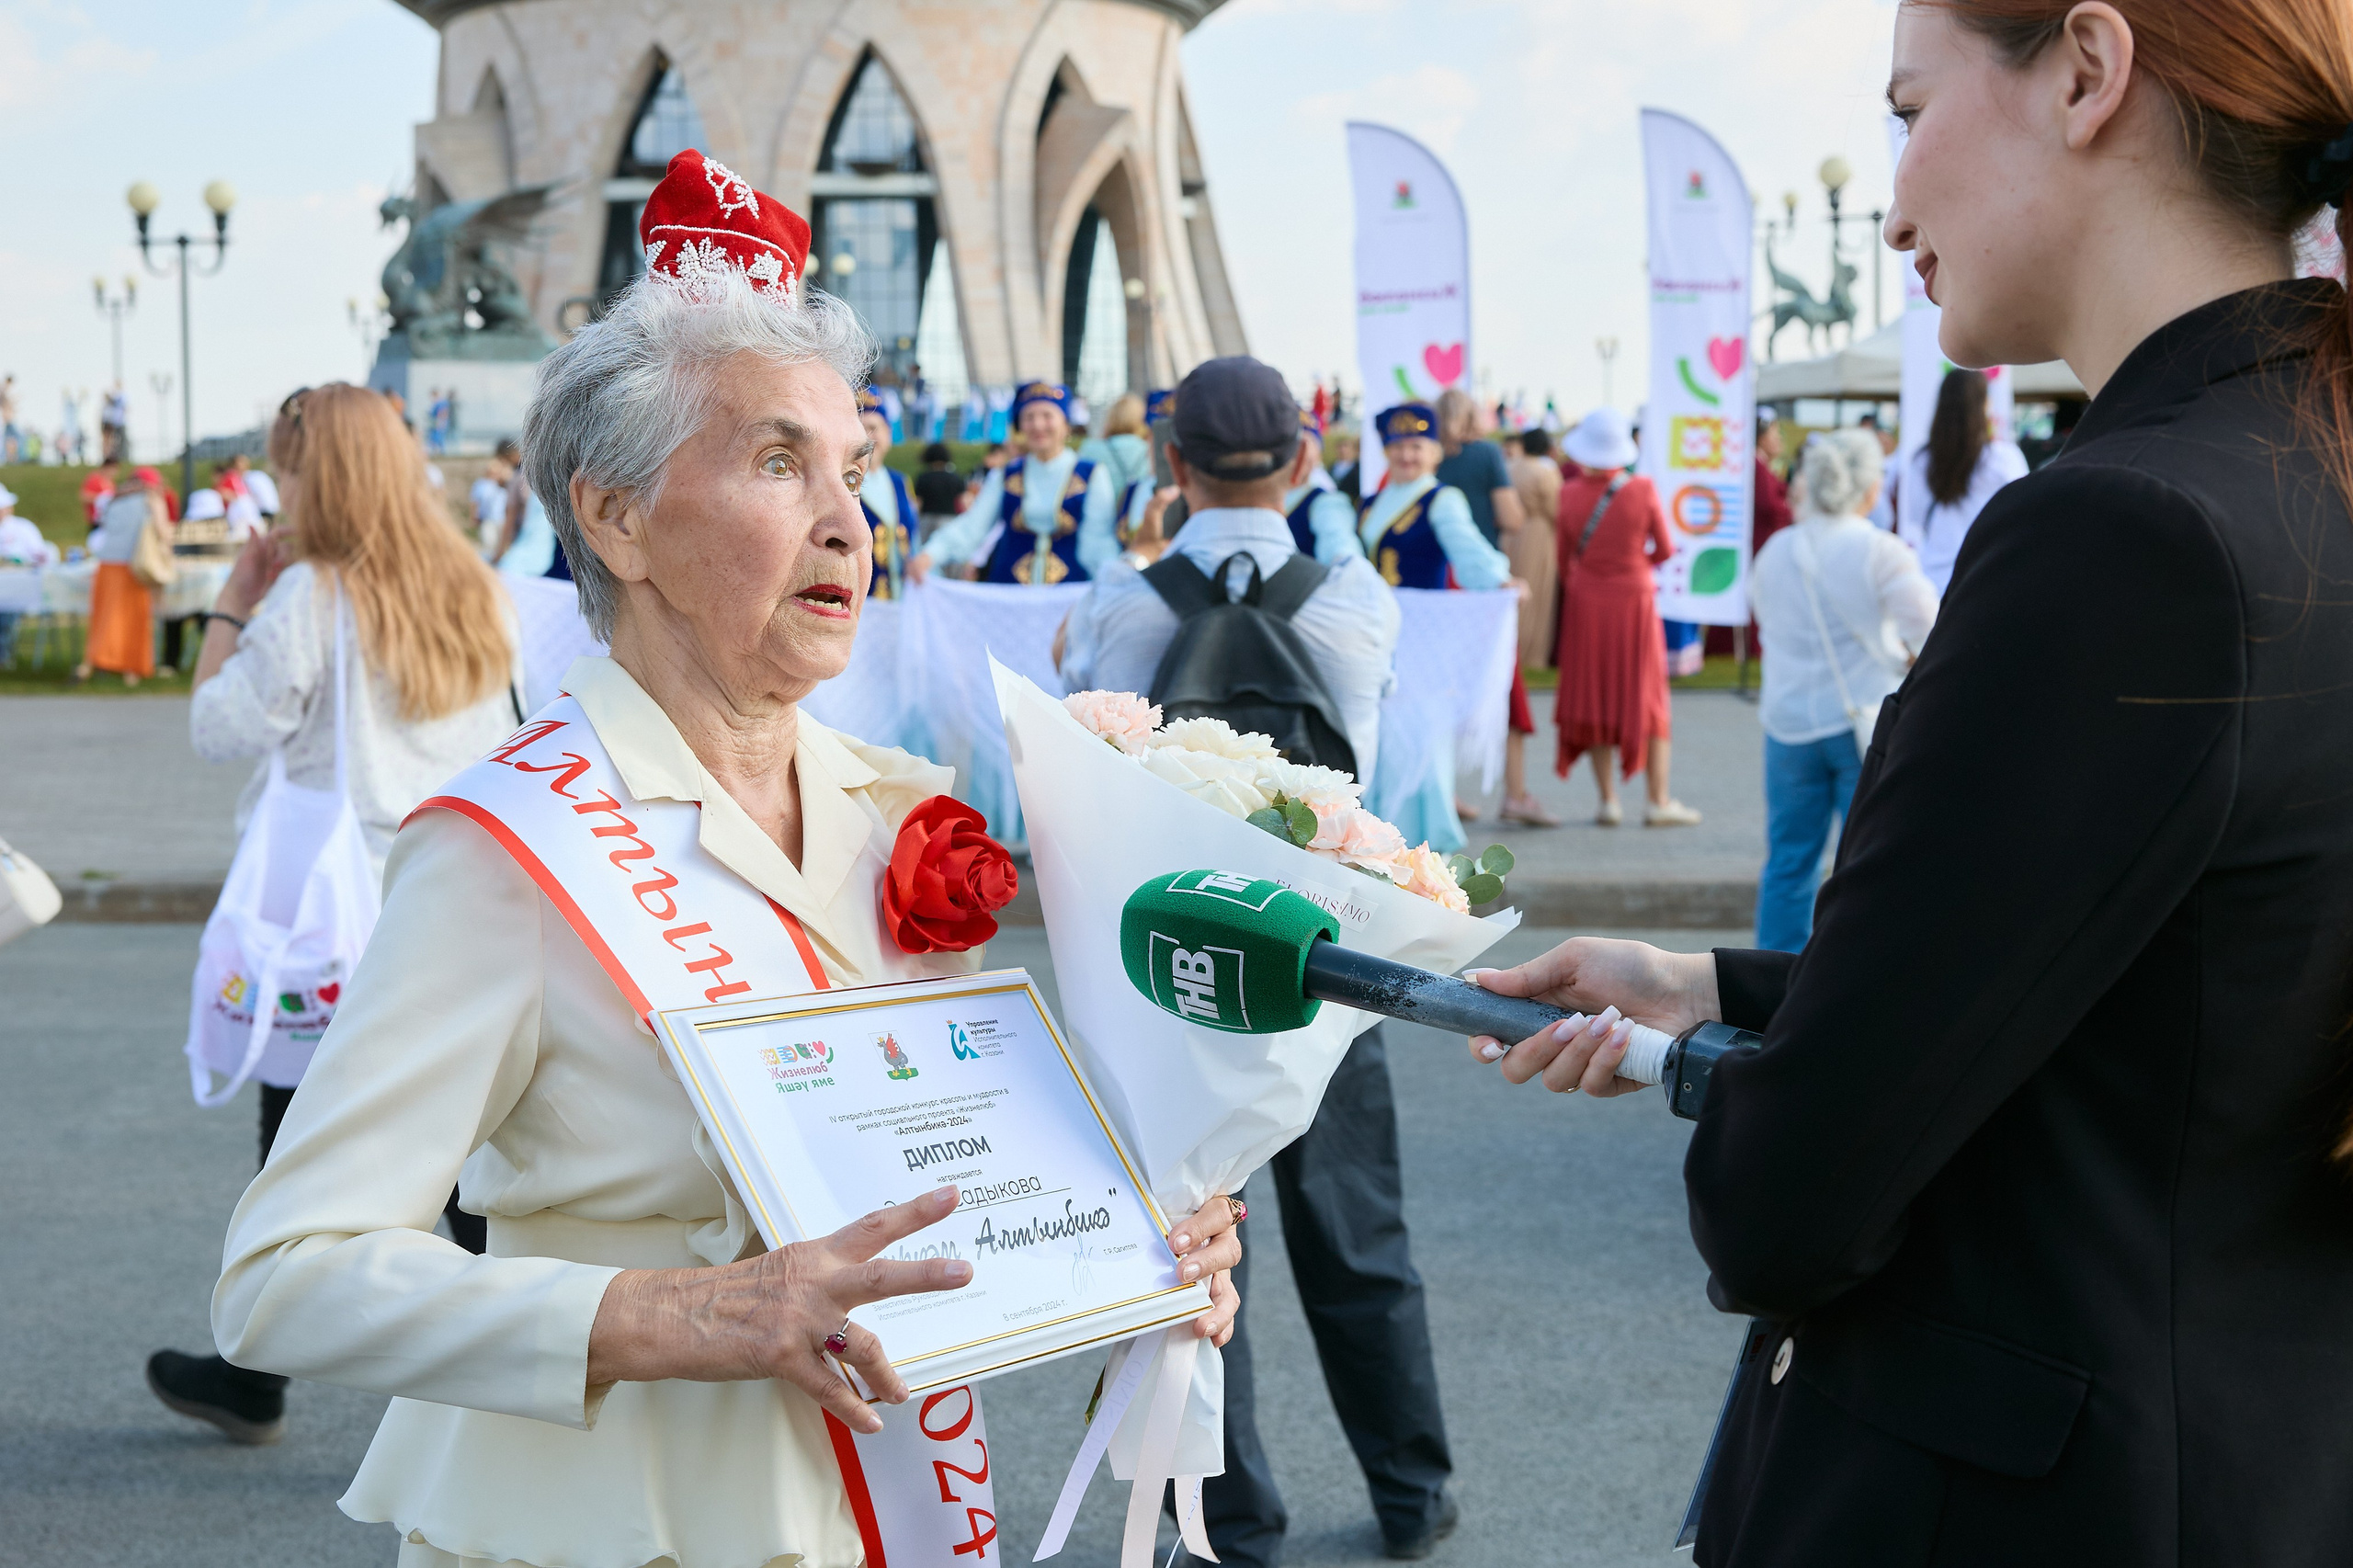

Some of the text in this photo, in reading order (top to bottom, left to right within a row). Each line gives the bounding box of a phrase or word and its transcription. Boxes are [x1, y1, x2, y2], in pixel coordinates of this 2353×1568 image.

[1172, 948, 1221, 1020] ТНВ
[965, 1018, 999, 1028] Управление
[970, 1027, 996, 1036] культуры
[767, 1061, 828, 1080] Жизнелюб
[775, 1076, 835, 1094] Яшәү яме
[829, 1115, 837, 1123] IV
[837, 1108, 874, 1122] открытый
[874, 1102, 911, 1117] городской
[911, 1099, 940, 1110] конкурс
[939, 1095, 968, 1106] красоты
[972, 1087, 1004, 1101] мудрости
[856, 1120, 882, 1133] рамках
[882, 1112, 927, 1127] социального
[927, 1108, 956, 1119] проекта
[894, 1115, 973, 1135] «Алтынбикә-2024»
[903, 1135, 993, 1172] ДИПЛОМ
[937, 1168, 983, 1183] награждается
[958, 1176, 1042, 1207] адыкова
[872, 1298, 913, 1312] Заместитель
[878, 1303, 933, 1322] Исполнительного
[933, 1295, 961, 1307] комитета
[1002, 1312, 1009, 1322] 8
[1009, 1305, 1044, 1321] сентября
[1042, 1299, 1062, 1312] 2024
